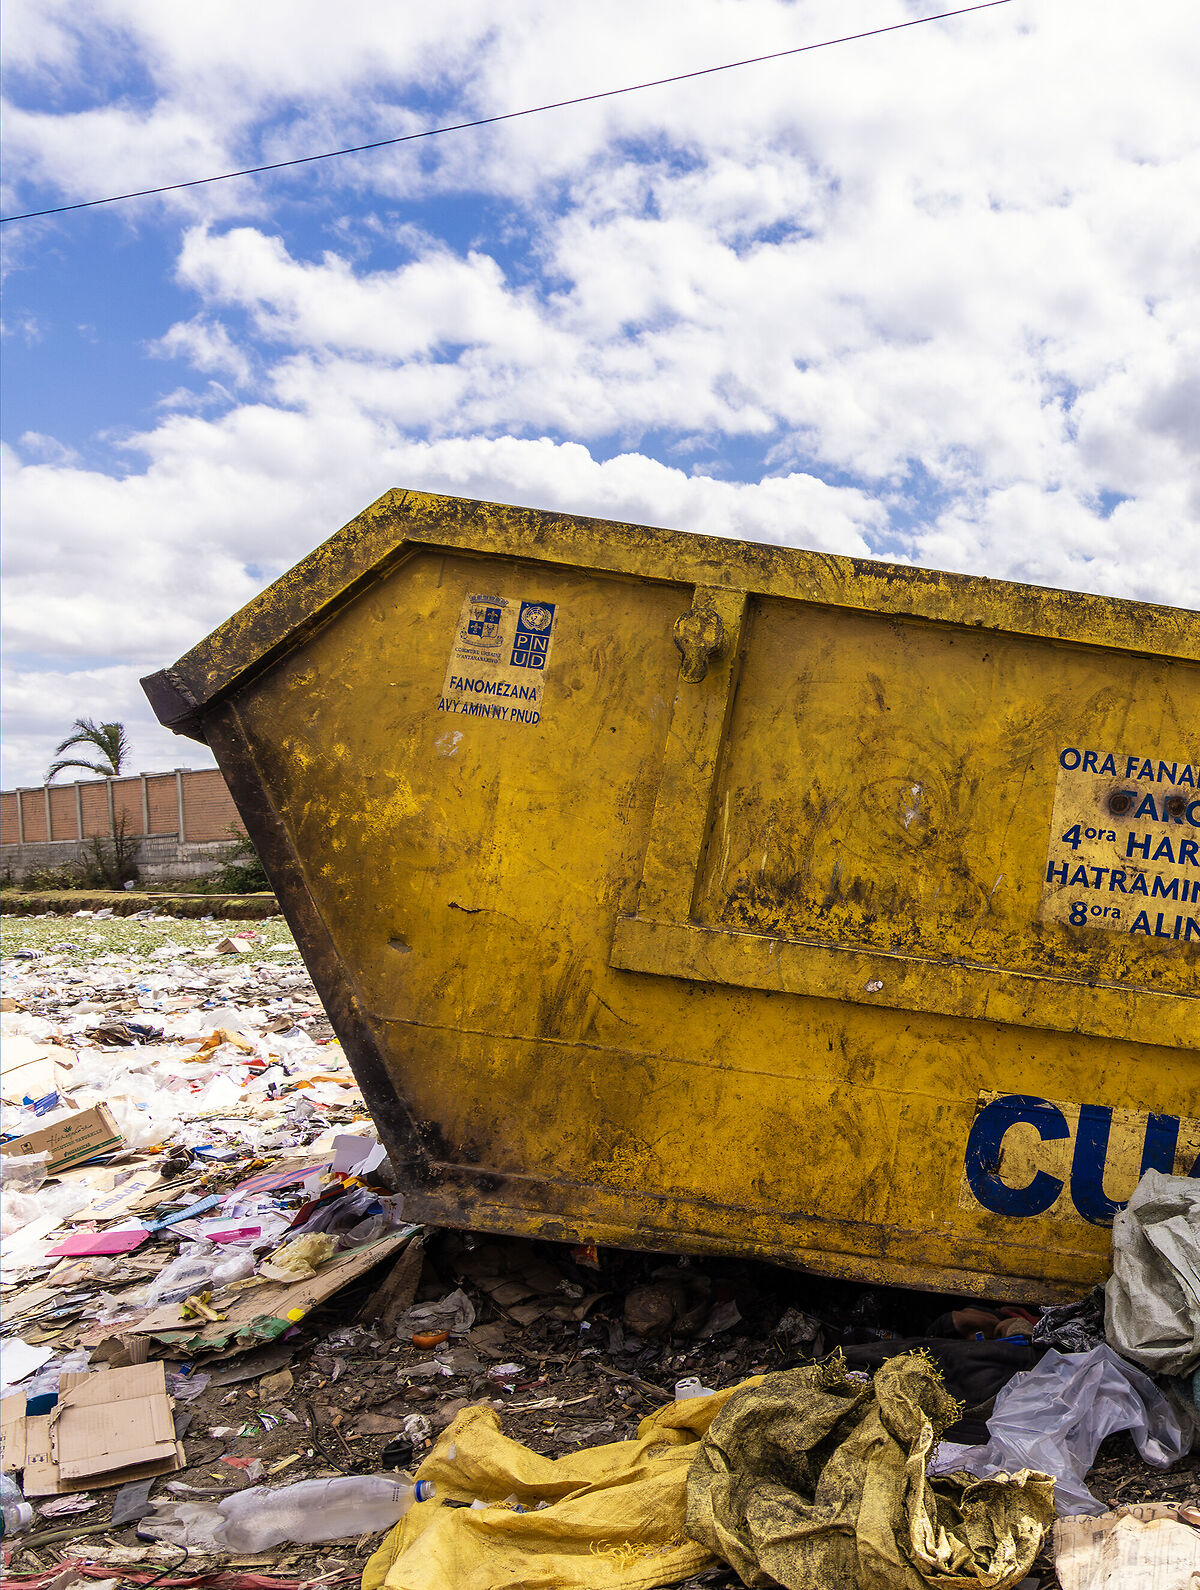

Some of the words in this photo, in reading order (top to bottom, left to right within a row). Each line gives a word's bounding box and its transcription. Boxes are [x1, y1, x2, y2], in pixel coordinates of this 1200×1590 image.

[449, 675, 537, 701] FANOMEZANA
[437, 697, 460, 713] AVY
[460, 702, 509, 720] AMIN'NY
[510, 708, 540, 725] PNUD
[1059, 747, 1117, 776] ORA
[1061, 824, 1117, 850] 4ora
[1068, 901, 1122, 927] 8ora
